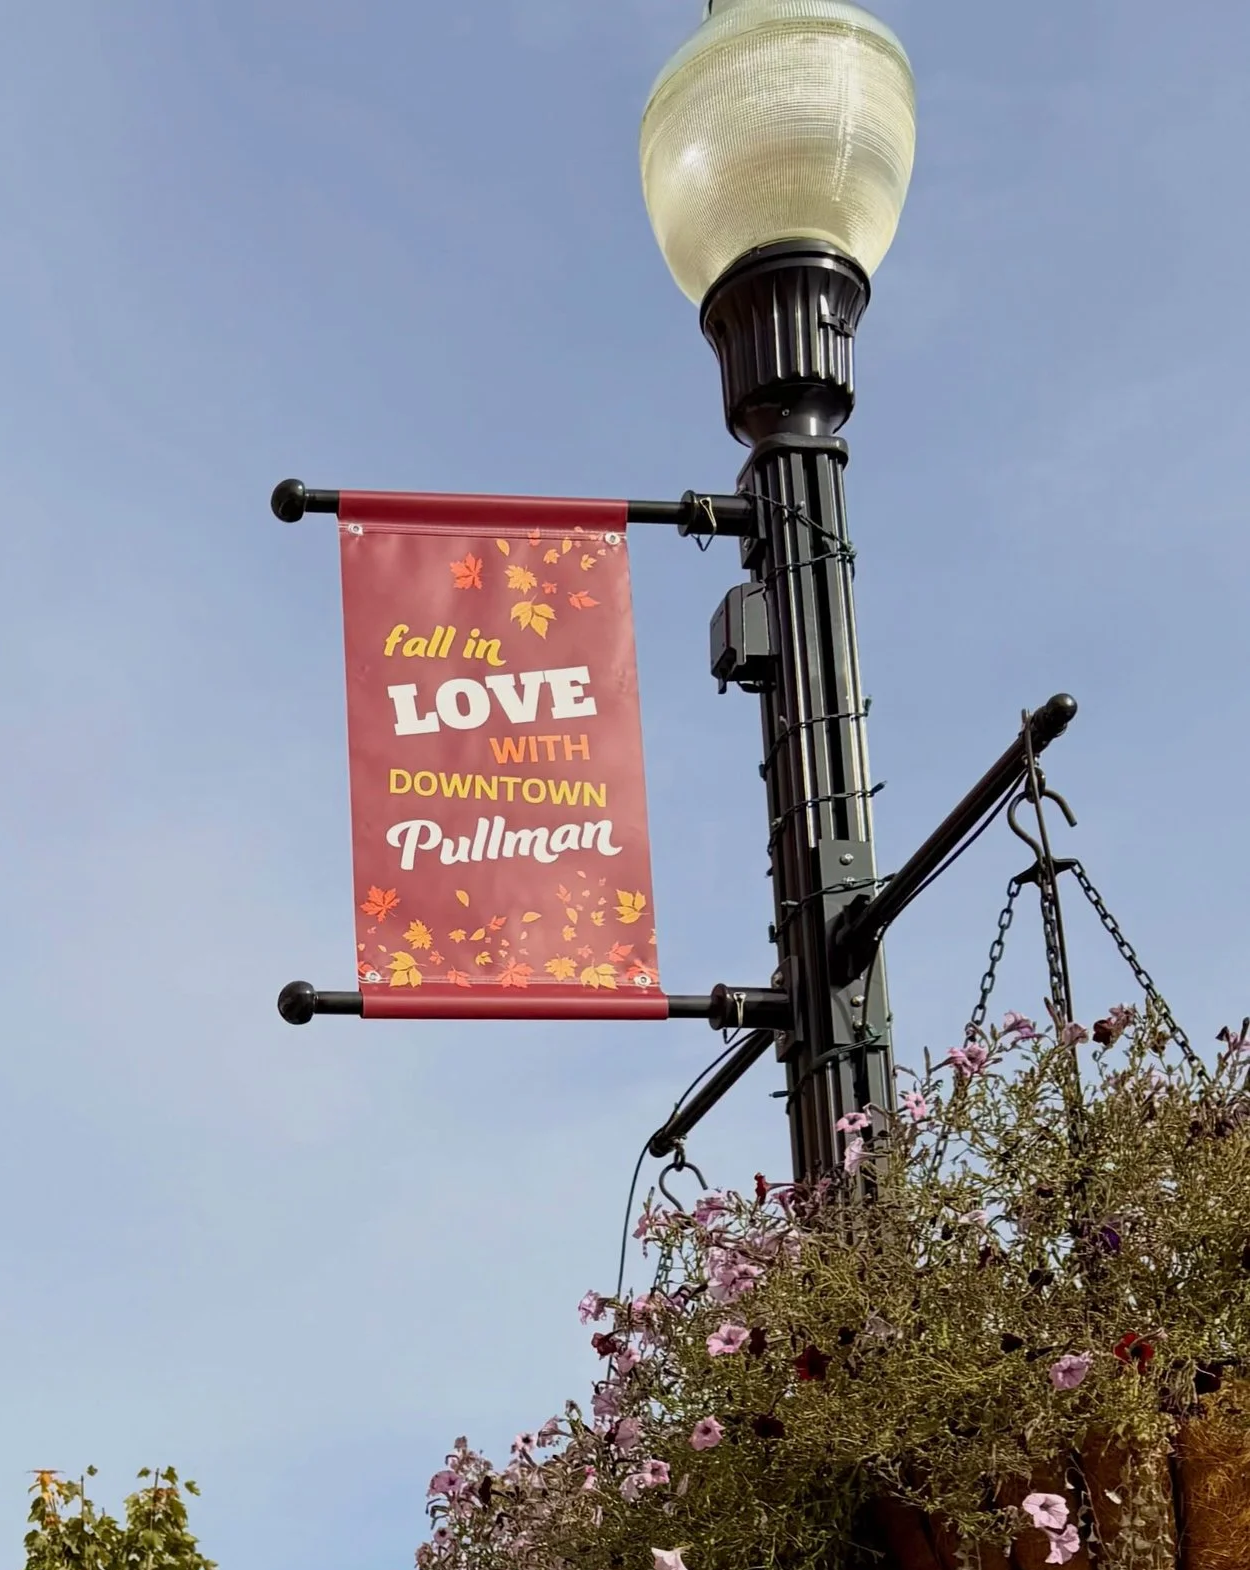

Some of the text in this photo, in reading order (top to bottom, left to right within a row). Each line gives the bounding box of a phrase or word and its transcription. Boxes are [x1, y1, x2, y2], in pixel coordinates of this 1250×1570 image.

[384, 624, 506, 666] fall in
[388, 666, 597, 736] LOVE
[489, 734, 590, 765] WITH
[389, 769, 607, 808] DOWNTOWN
[385, 816, 623, 871] Pullman
